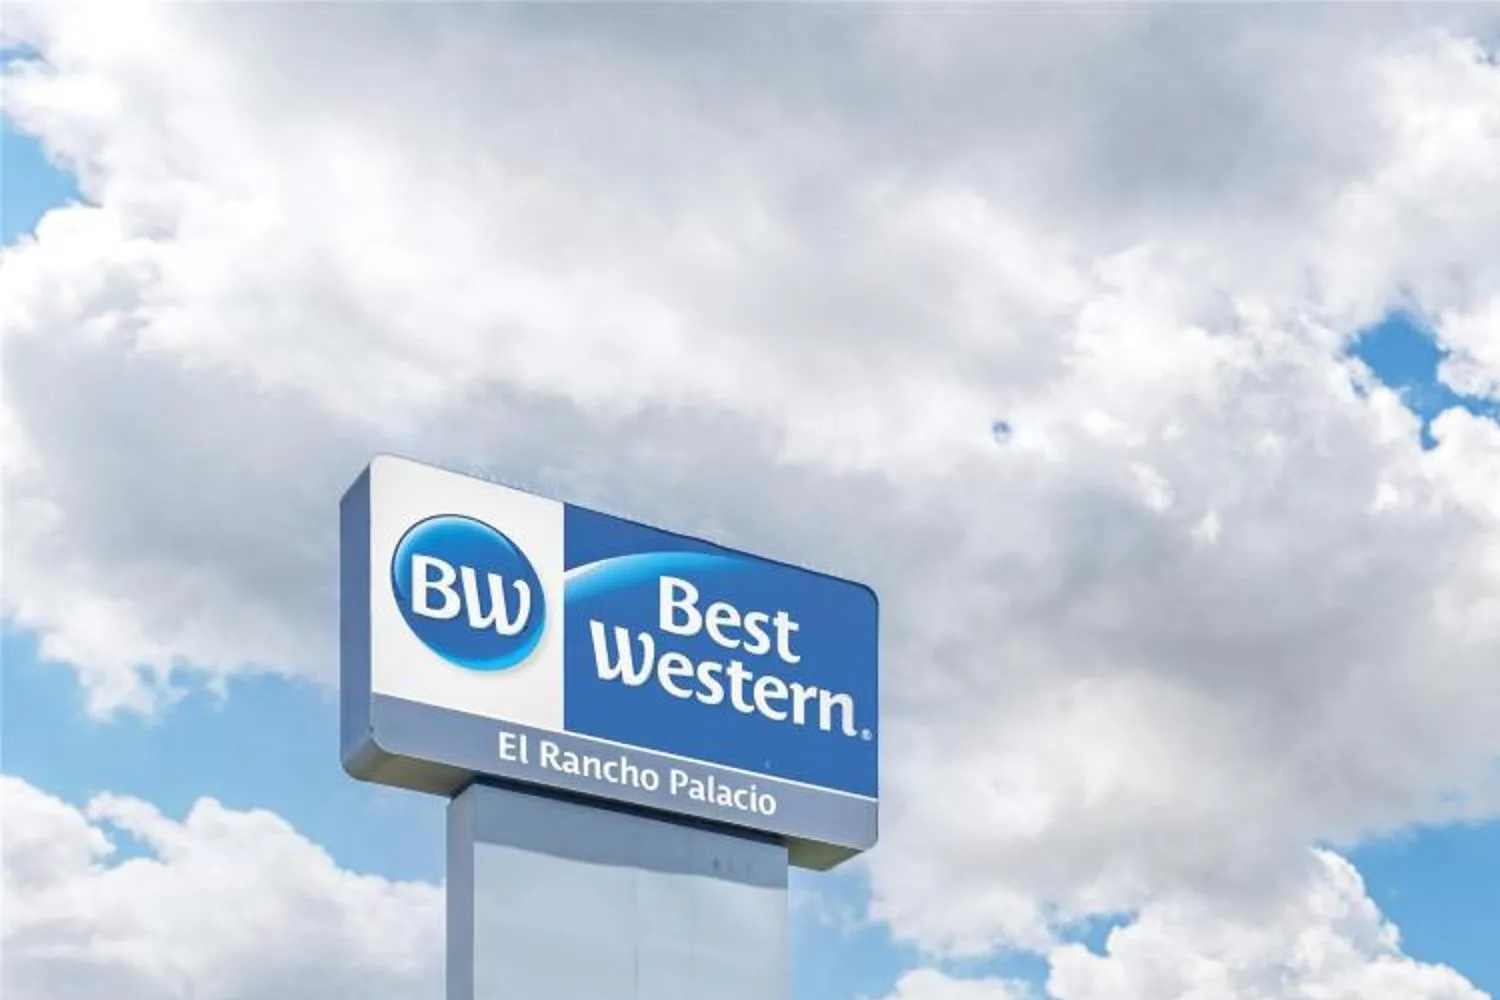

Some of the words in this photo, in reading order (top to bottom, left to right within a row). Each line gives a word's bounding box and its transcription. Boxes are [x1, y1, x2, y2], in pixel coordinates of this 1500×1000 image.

[411, 553, 531, 636] BW
[659, 575, 801, 664] Best
[589, 618, 858, 737] Western
[498, 730, 528, 765] El
[540, 740, 660, 792] Rancho
[669, 768, 778, 816] Palacio
